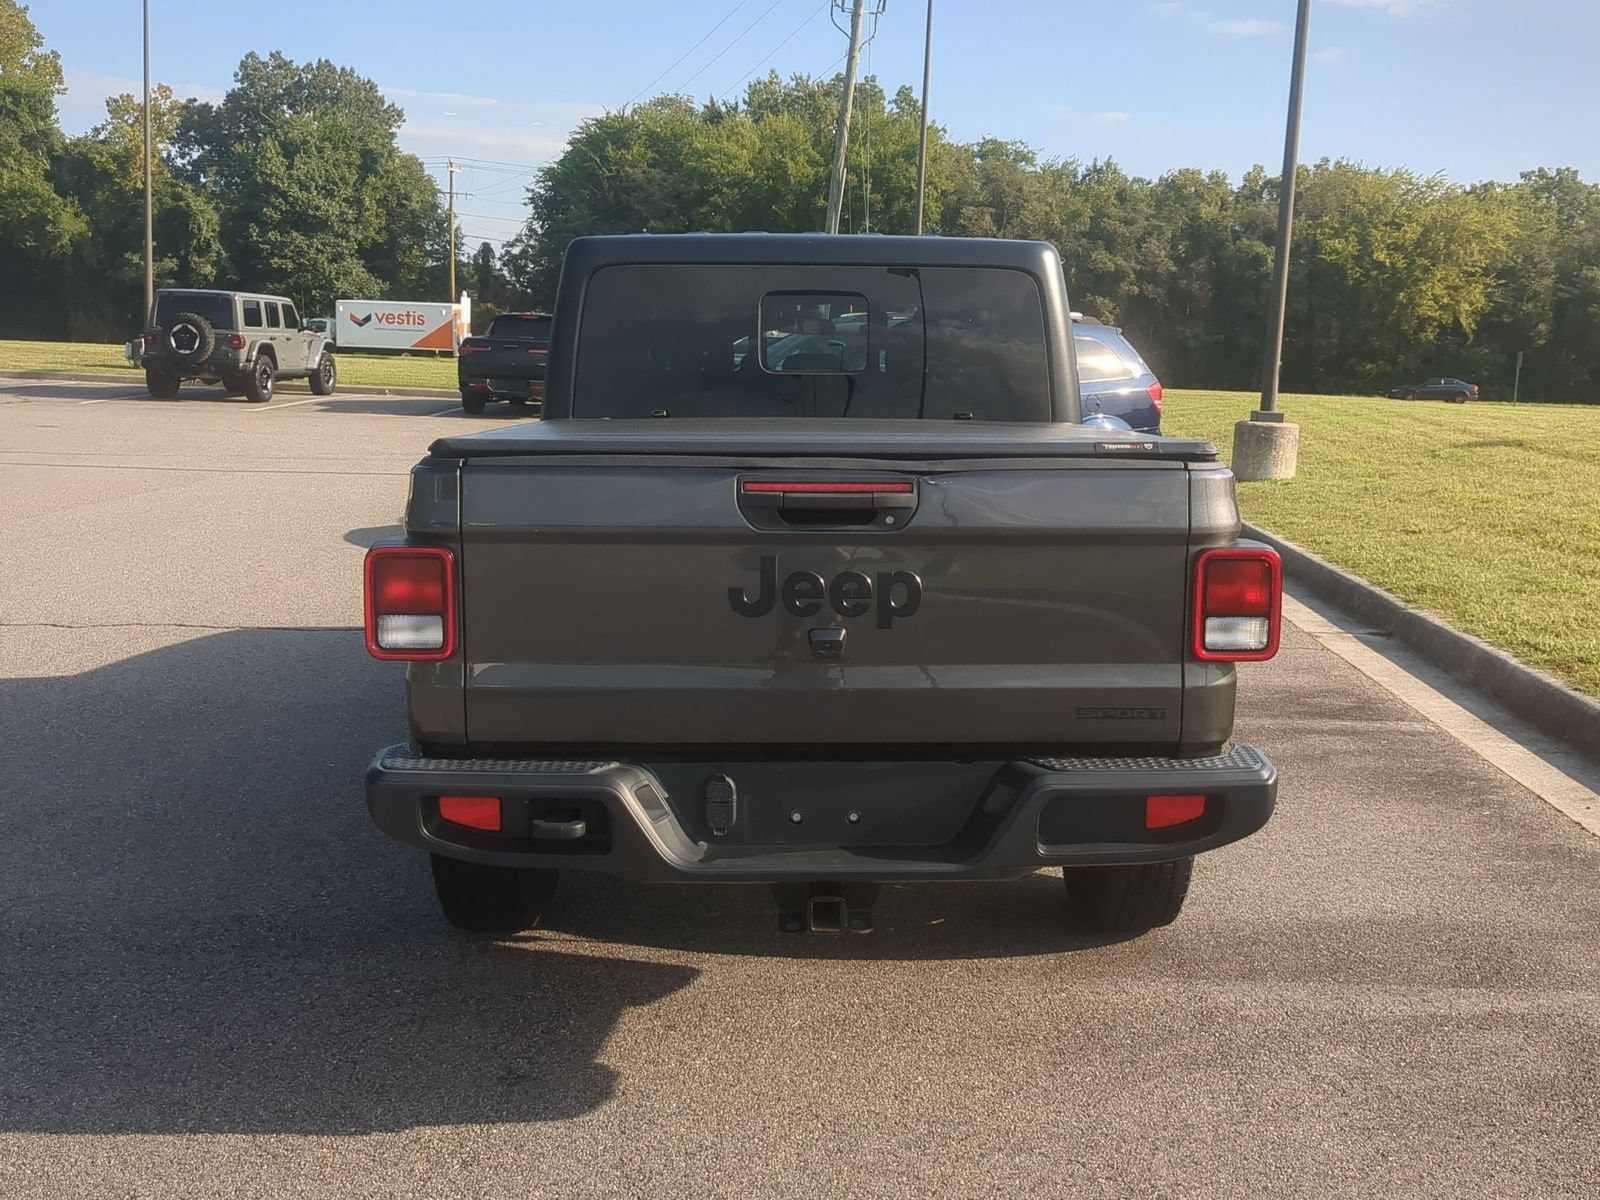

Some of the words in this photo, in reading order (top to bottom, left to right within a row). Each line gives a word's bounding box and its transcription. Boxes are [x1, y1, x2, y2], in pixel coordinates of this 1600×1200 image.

[374, 310, 426, 326] vestis
[728, 555, 923, 630] Jeep
[1076, 707, 1167, 719] SPORT
